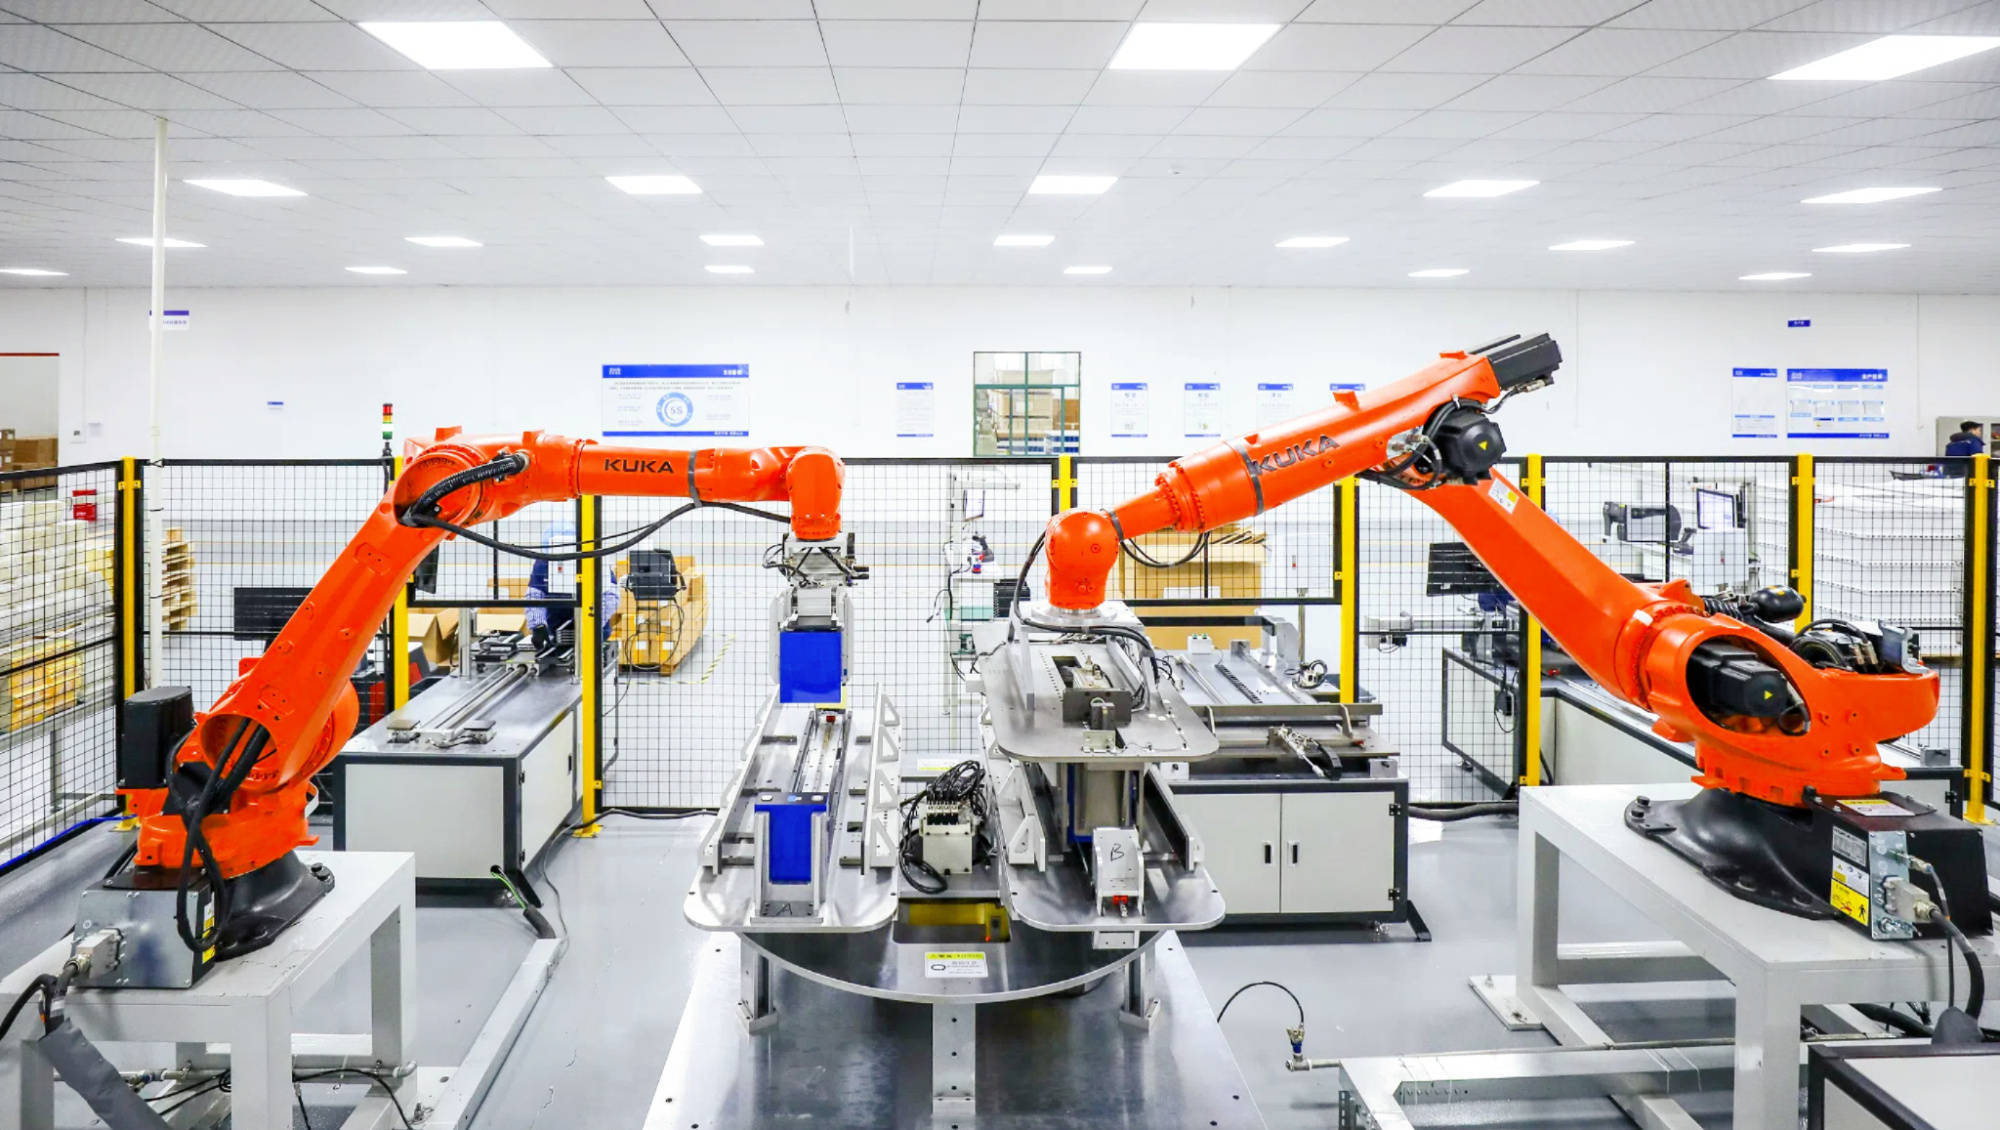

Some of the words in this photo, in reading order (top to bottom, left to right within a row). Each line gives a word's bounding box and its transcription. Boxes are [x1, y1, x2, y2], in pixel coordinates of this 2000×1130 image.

[1251, 434, 1340, 475] KUKA
[604, 458, 674, 474] KUKA
[1110, 842, 1125, 862] B
[775, 902, 793, 916] A
